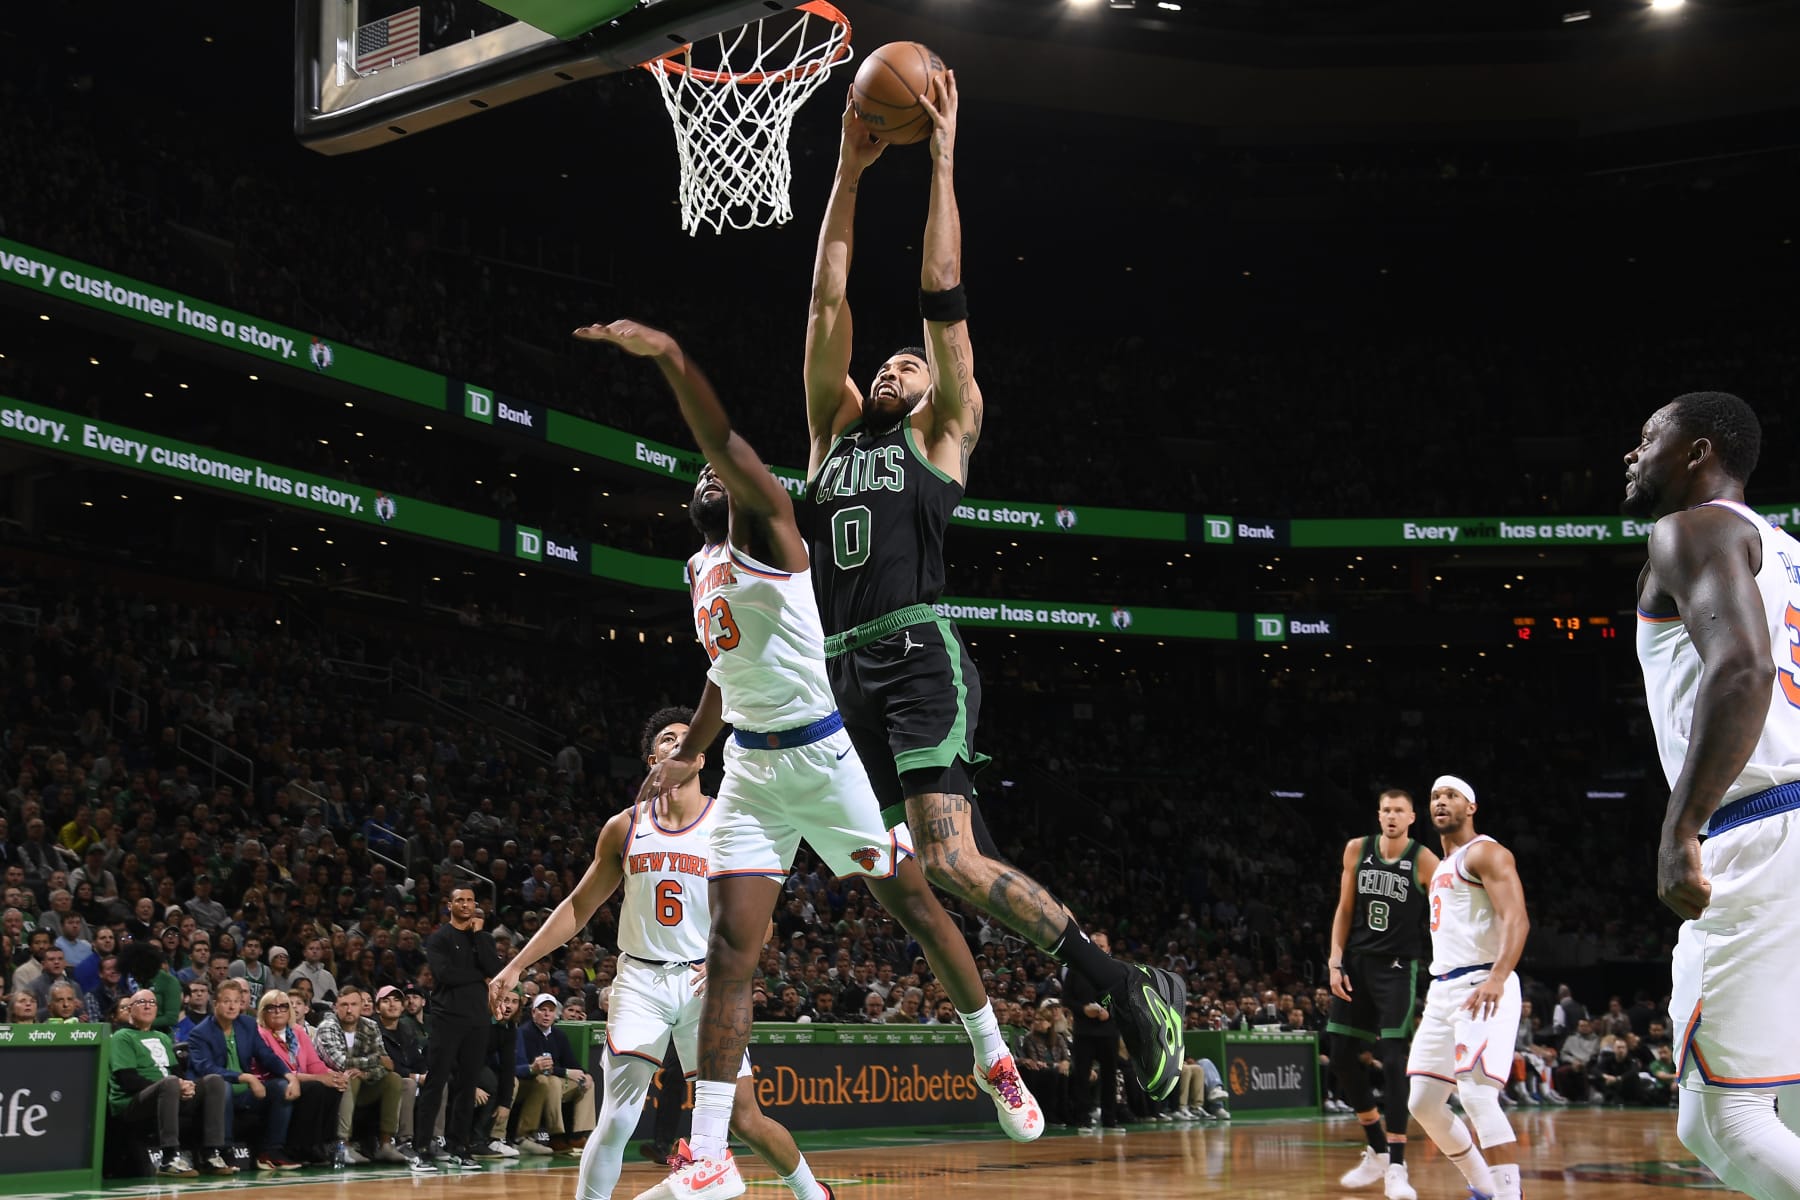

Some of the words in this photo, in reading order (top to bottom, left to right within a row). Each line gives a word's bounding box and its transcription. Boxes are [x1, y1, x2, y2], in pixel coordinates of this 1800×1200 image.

[0, 252, 56, 287] very
[60, 270, 173, 319] customer
[177, 300, 217, 333] has
[222, 319, 235, 338] a
[239, 324, 297, 358] story.
[467, 390, 491, 416] TD
[498, 402, 532, 427] Bank
[1, 409, 70, 443] story.
[83, 424, 147, 463] Every
[151, 447, 252, 485] customer
[256, 467, 292, 494] has
[296, 481, 308, 498] a
[311, 485, 364, 514] story.
[636, 441, 677, 473] Every
[977, 508, 990, 521] a
[992, 508, 1044, 528] story.
[1206, 519, 1231, 538] TD
[1238, 524, 1275, 539] Bank
[1403, 523, 1458, 542] Every
[1462, 522, 1497, 538] win
[1500, 521, 1537, 539] has
[1539, 524, 1552, 538] a
[1555, 522, 1611, 541] story.
[518, 530, 540, 555] TD
[546, 540, 578, 562] Bank
[831, 505, 871, 571] 0
[698, 595, 741, 661] 23
[1000, 603, 1034, 621] has
[1036, 610, 1048, 622] a
[1051, 609, 1101, 629] story.
[1257, 618, 1282, 636] TD
[1290, 620, 1330, 634] Bank
[629, 852, 666, 876] NEW
[1358, 869, 1409, 902] CELTICS
[656, 879, 684, 927] 6
[1368, 900, 1390, 932] 8
[29, 1030, 56, 1042] xfinity
[70, 1029, 97, 1041] xfinity
[1251, 1066, 1278, 1090] Sun
[1278, 1064, 1301, 1090] Life
